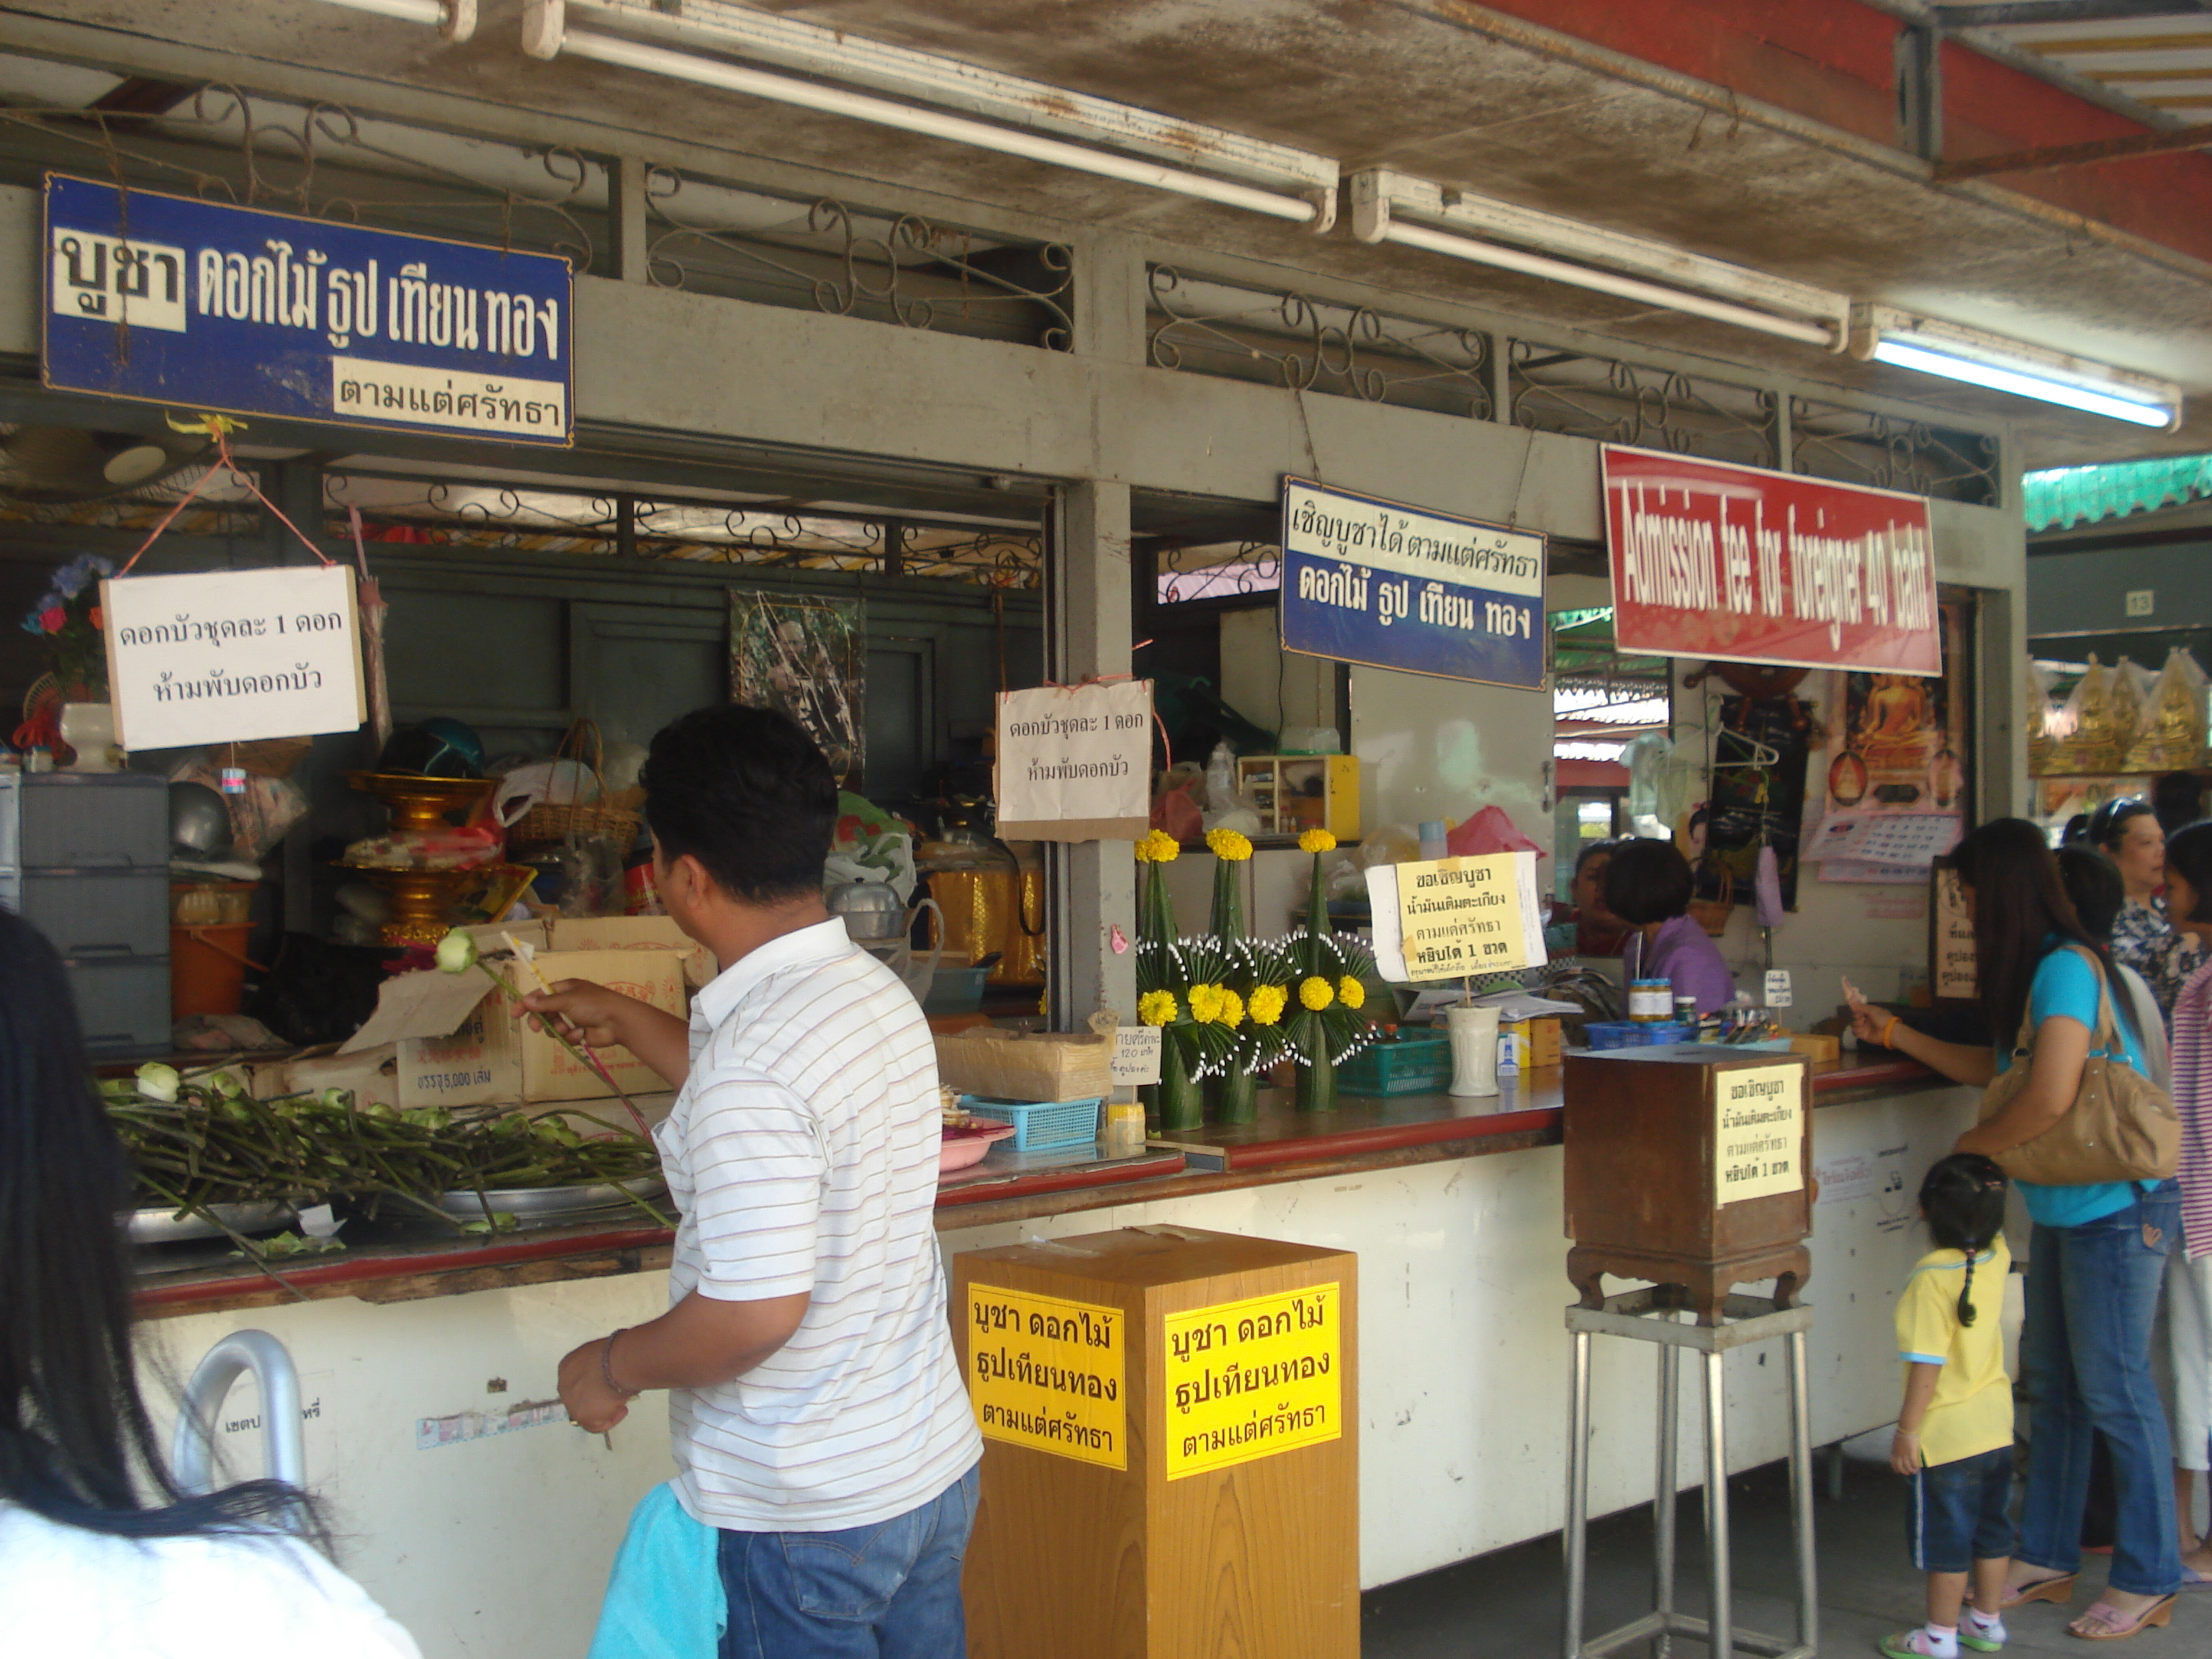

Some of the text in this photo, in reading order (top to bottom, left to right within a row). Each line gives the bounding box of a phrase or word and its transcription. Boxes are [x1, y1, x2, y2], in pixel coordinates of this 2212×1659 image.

[60, 235, 179, 316] บูชา
[197, 239, 328, 331] ดอกไม้
[327, 259, 379, 349] ธูป
[339, 377, 561, 429] ตามแต่ศรัทธา
[1298, 563, 1531, 640] ดอกไม้ ธูป เทียน ทอง
[120, 611, 343, 647] ดอกบัวชุดละ 1 ดอก
[153, 661, 323, 703] ห้ามพับดอกบัว
[1010, 712, 1143, 739] ดอกบัวชุดละ 1 ดอก
[1027, 753, 1129, 782] ห้ามพับดอกบัว
[1416, 867, 1492, 889] ขอเชิญบูชา
[1416, 917, 1501, 941] ตามแต่ศรัทธา
[1416, 939, 1462, 964] หยิบได้
[1467, 944, 1477, 958] 1
[1121, 1048, 1138, 1058] 120
[1730, 1079, 1785, 1102] ขอเชิญบูชา
[1727, 1133, 1788, 1157] ตามแต่ศรัทธา
[1725, 1156, 1760, 1183] หยิบได้
[1761, 1162, 1768, 1177] 1
[974, 1300, 1113, 1351] บูชา ดอกไม้
[1171, 1293, 1327, 1364] บูชา ดอกไม้
[976, 1346, 1118, 1403] ธูปเทียนทอง
[1174, 1350, 1331, 1414] ธูปเทียนทอง
[982, 1401, 1114, 1454] ตามแต่ศรัทธา
[1182, 1401, 1326, 1459] ตามแต่ศรัทธา
